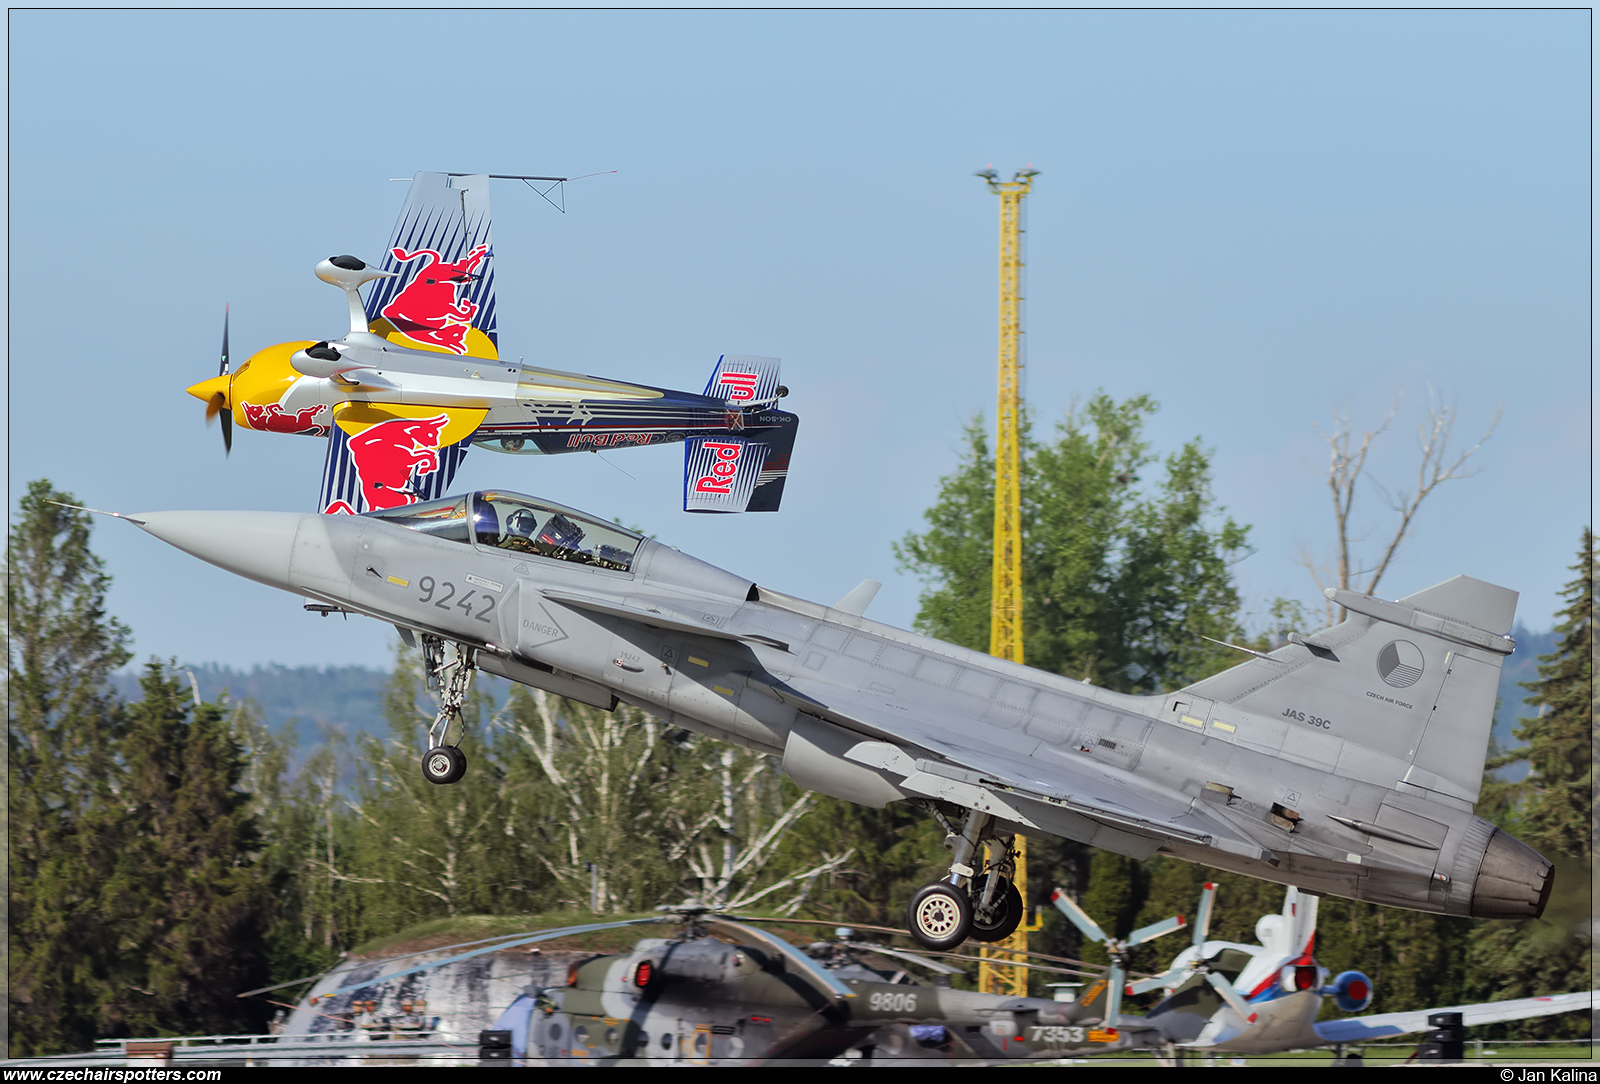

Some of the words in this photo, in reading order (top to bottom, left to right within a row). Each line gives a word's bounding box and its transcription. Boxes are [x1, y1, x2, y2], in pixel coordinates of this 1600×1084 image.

[566, 433, 610, 448] Bull
[609, 433, 653, 446] Red
[695, 442, 742, 494] Red
[418, 576, 496, 624] 9242
[522, 619, 559, 638] DANGER
[1366, 691, 1385, 701] CZECH
[1394, 700, 1413, 710] FORCE
[1282, 708, 1306, 722] JAS
[1307, 715, 1332, 730] 39C
[869, 992, 917, 1013] 9806
[1030, 1026, 1085, 1042] 7353
